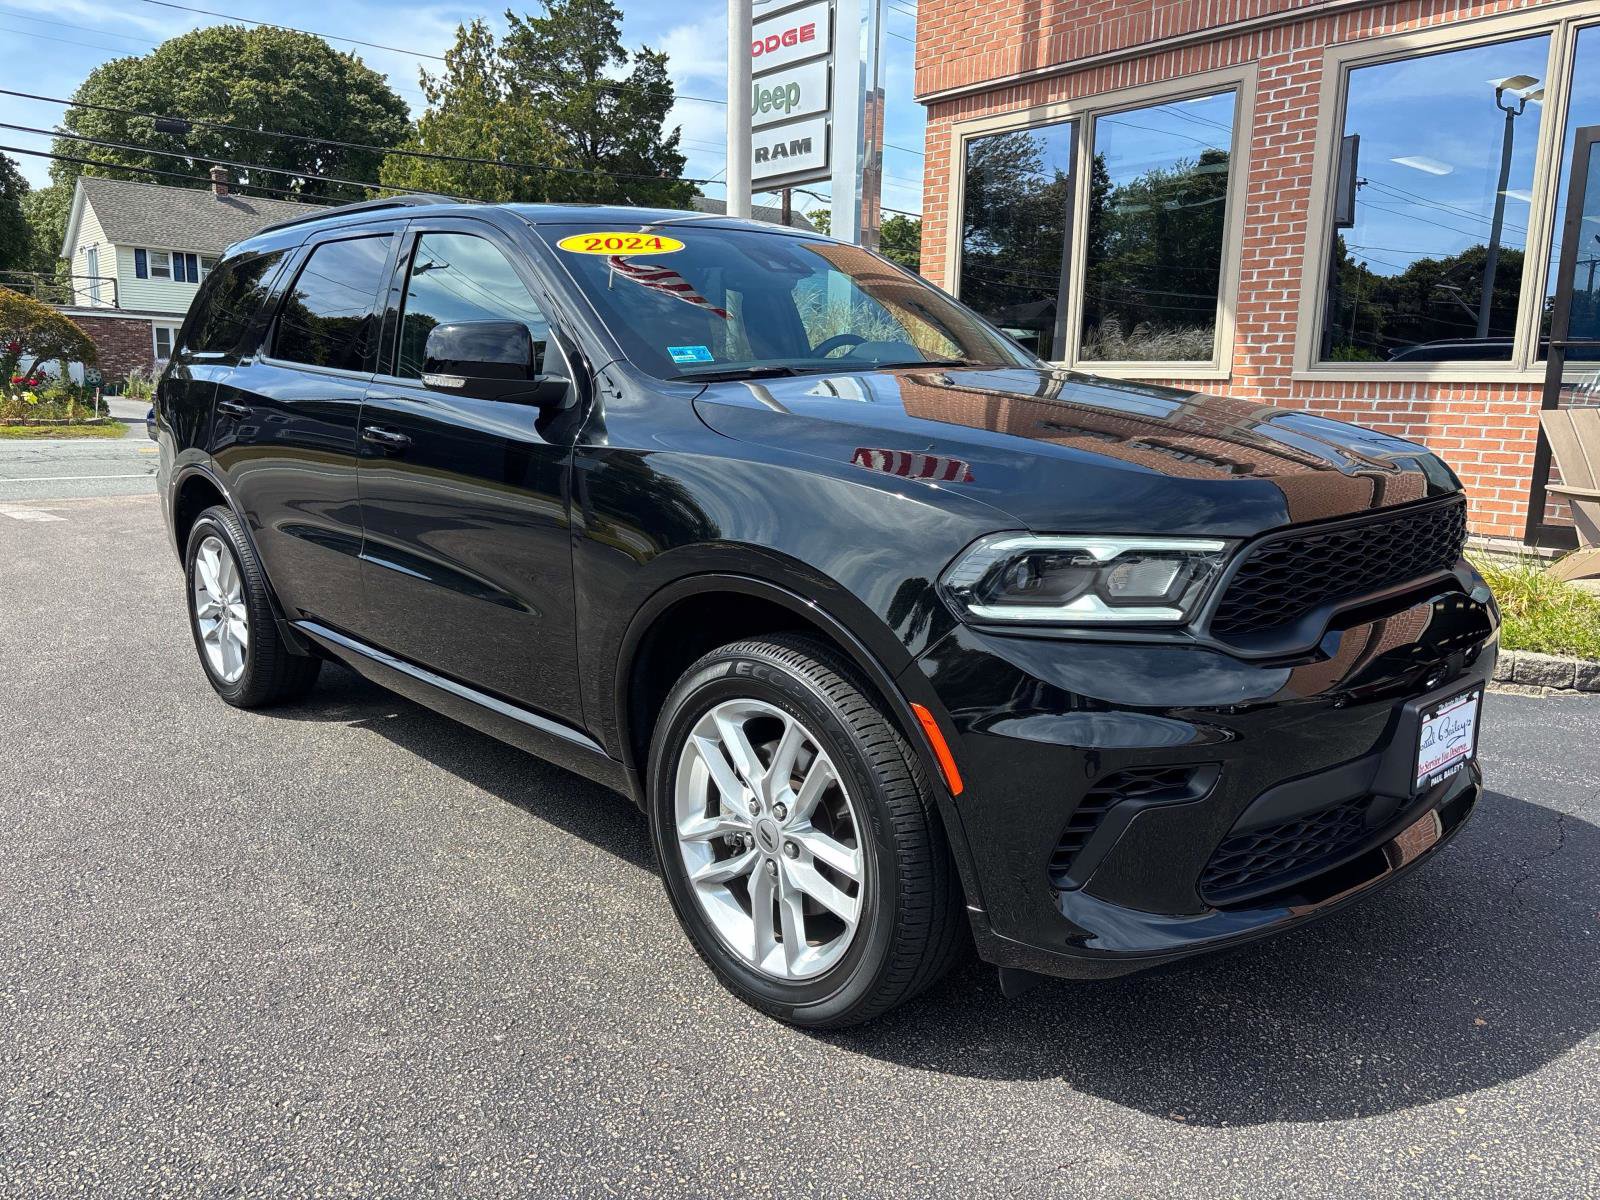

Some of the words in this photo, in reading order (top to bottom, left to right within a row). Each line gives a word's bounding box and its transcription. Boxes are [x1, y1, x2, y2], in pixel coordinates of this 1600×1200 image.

[752, 22, 815, 58] ODGE
[752, 81, 800, 116] Jeep
[754, 137, 812, 164] RAM
[584, 237, 665, 251] 2024
[1430, 773, 1443, 788] PAUL
